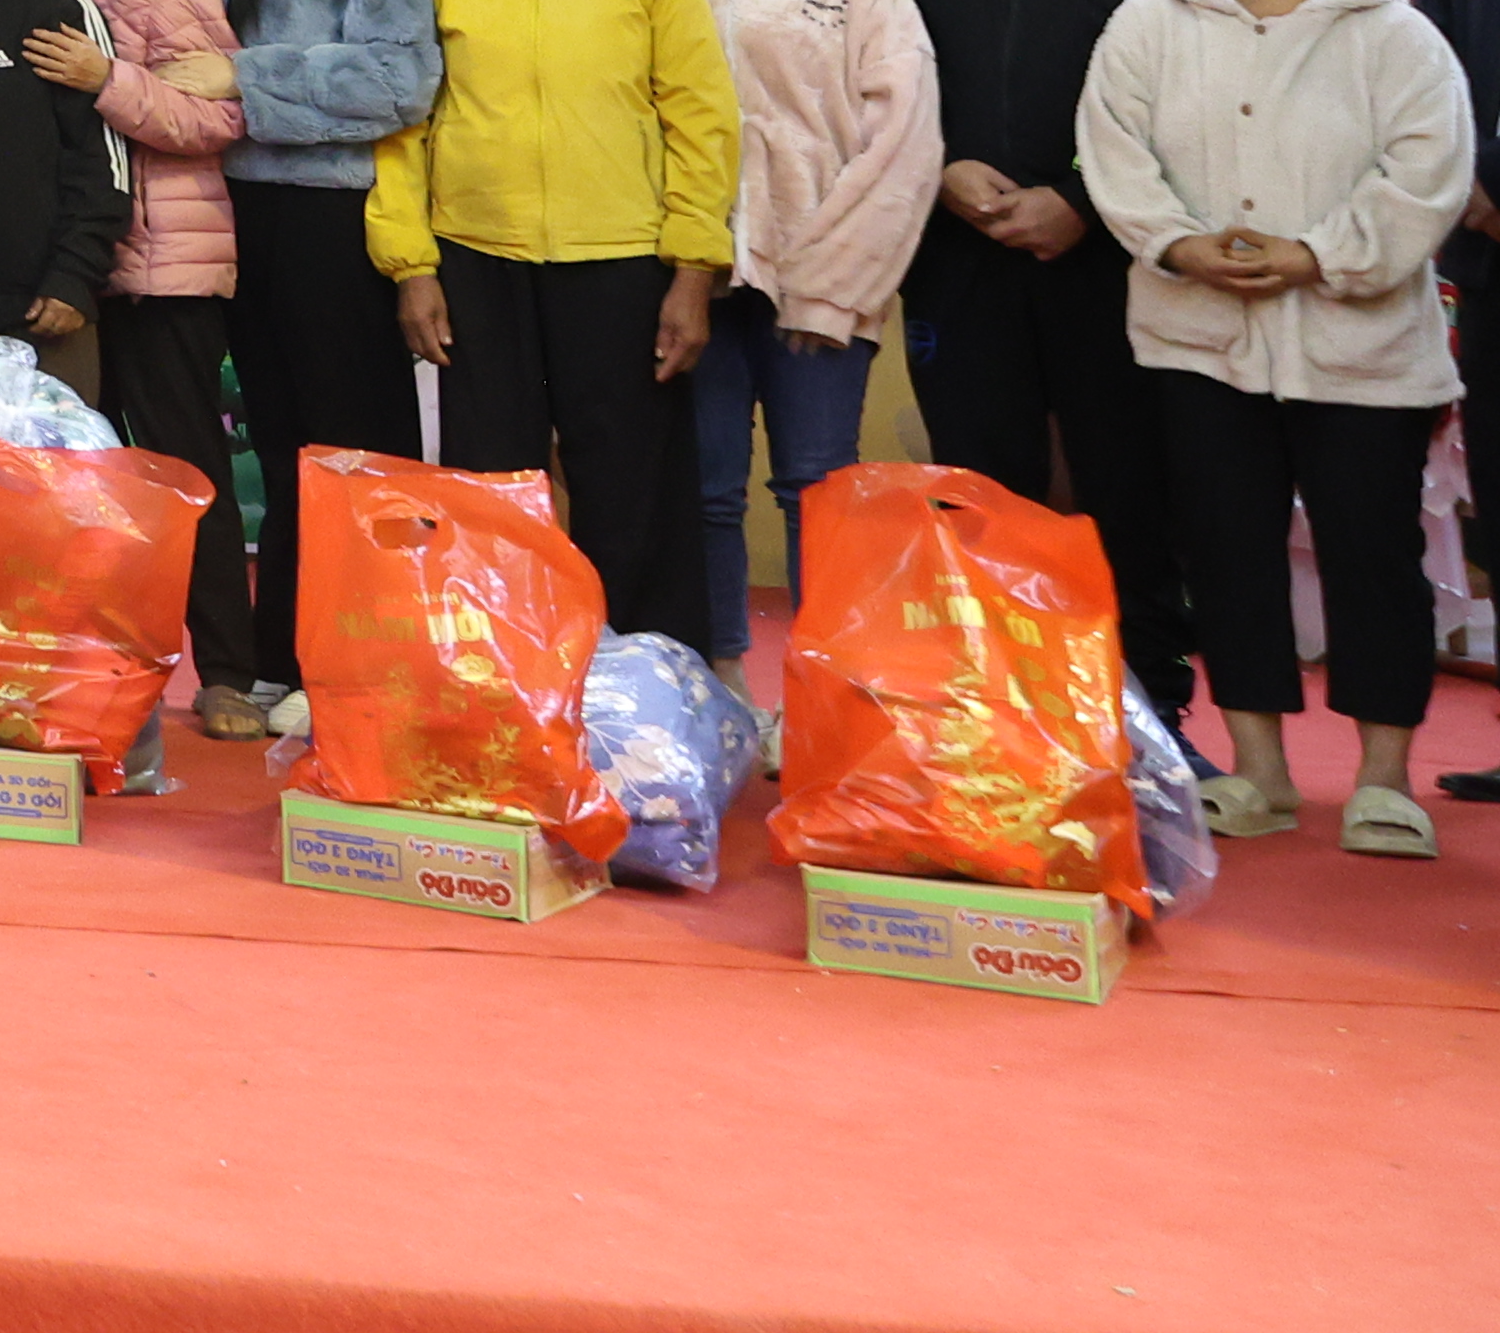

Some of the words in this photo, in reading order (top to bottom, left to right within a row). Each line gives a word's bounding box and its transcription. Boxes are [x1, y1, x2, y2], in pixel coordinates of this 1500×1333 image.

[16, 791, 26, 803] 3
[30, 789, 62, 809] GÓI
[418, 871, 454, 896] Đỏ
[455, 879, 511, 908] Gấu
[972, 945, 1013, 975] Đỏ
[1013, 952, 1083, 983] Gấu
